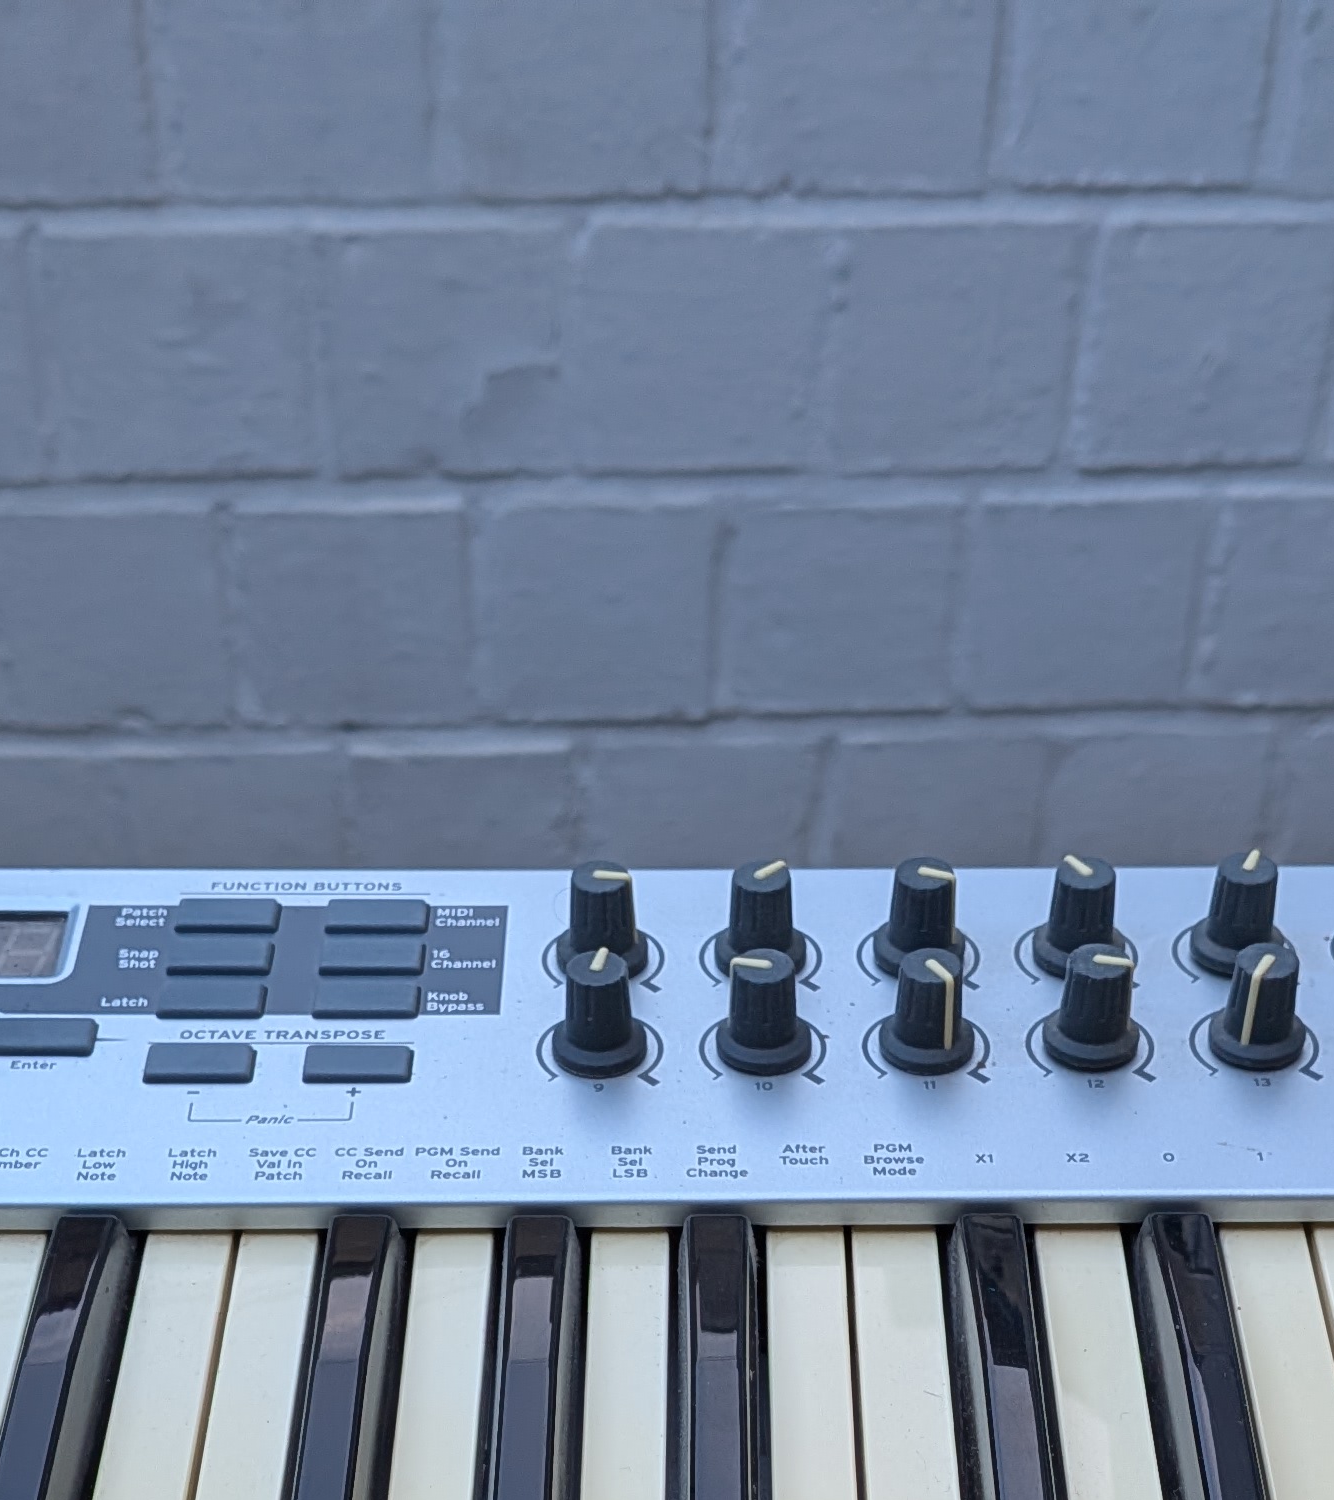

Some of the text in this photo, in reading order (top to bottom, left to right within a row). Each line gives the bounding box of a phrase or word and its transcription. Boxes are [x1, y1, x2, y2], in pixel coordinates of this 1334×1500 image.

[210, 881, 404, 892] FUNCTION BUTTONS
[121, 907, 167, 917] Patch
[436, 907, 475, 917] MIDI
[115, 916, 166, 928] Select
[434, 917, 500, 928] Channel
[118, 949, 159, 961] Snap
[432, 950, 451, 960] 16
[118, 958, 157, 969] Shot
[431, 958, 497, 969] Channel
[100, 996, 149, 1008] Latch
[427, 991, 468, 1001] Knob
[426, 1001, 485, 1013] Bypass
[179, 1029, 386, 1041] OCTAVE TRANSPOSE
[9, 1059, 58, 1072] Enter
[753, 1080, 774, 1092] 10
[922, 1080, 938, 1092] 11
[1085, 1078, 1106, 1090] 12
[1253, 1076, 1272, 1088] 13
[245, 1112, 295, 1126] Panic
[26, 1146, 50, 1158] CC
[76, 1147, 127, 1159] Latch
[167, 1146, 218, 1159] Latch
[248, 1146, 317, 1159] Save CC
[333, 1145, 405, 1158] CC Send
[414, 1145, 501, 1158] PGM Send
[521, 1145, 565, 1158] Bank
[610, 1145, 654, 1157] Bank
[695, 1144, 738, 1157] Send
[781, 1144, 827, 1156] After
[872, 1143, 913, 1155] PGM
[81, 1158, 117, 1170] Low
[255, 1158, 303, 1170] Val In
[354, 1157, 379, 1169] On
[444, 1157, 469, 1169] On
[528, 1156, 555, 1168] Sel
[617, 1156, 644, 1168] Sel
[696, 1156, 737, 1170] Prog
[778, 1155, 830, 1167] Touch
[863, 1155, 925, 1166] Browse
[973, 1152, 995, 1165] X1
[1065, 1152, 1090, 1165] X2
[171, 1158, 209, 1173] High
[75, 1169, 117, 1182] Note
[169, 1170, 209, 1182] Note
[253, 1169, 303, 1182] Patch
[341, 1169, 393, 1181] Recall
[429, 1169, 482, 1181] Recall
[521, 1167, 563, 1180] MSB
[612, 1167, 650, 1180] LSB
[685, 1166, 749, 1181] Change
[871, 1166, 918, 1178] Mode
